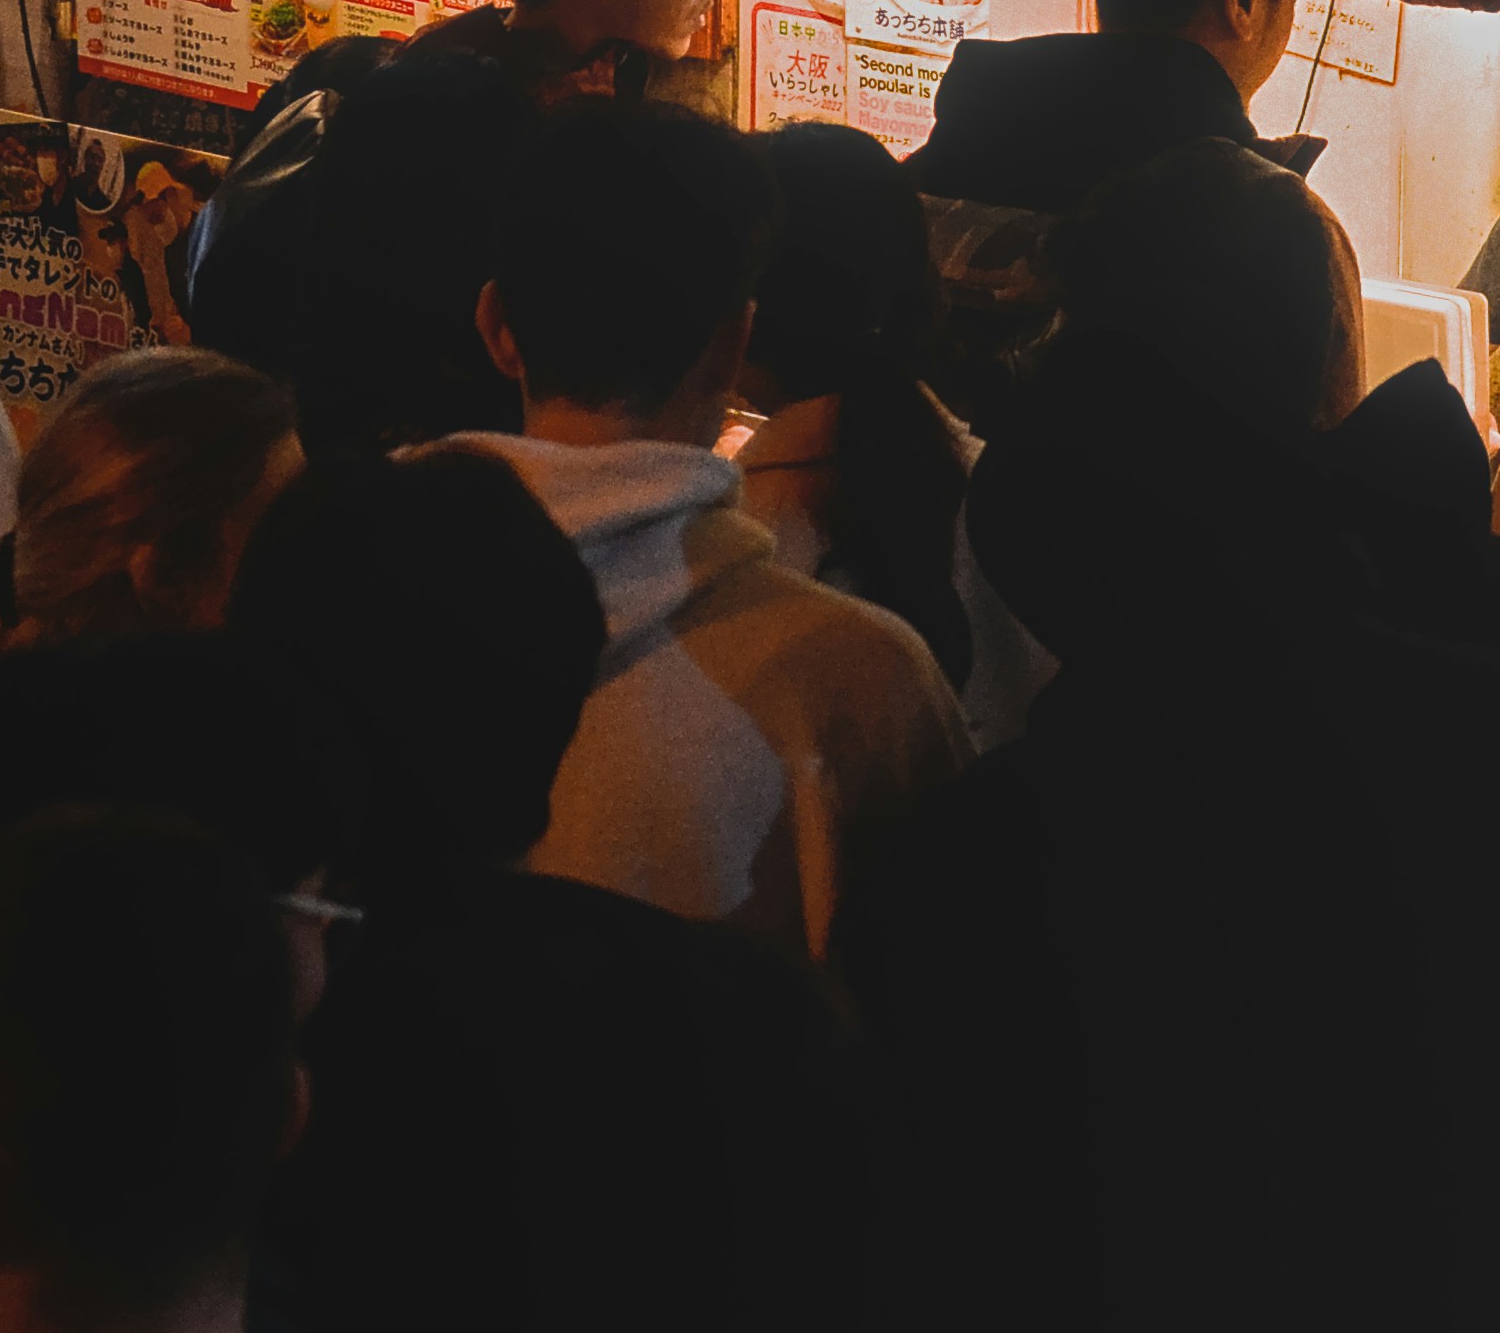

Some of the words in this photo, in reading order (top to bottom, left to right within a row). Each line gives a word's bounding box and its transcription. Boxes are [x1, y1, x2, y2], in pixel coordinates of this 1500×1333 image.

[874, 6, 965, 41] あっちち本舗
[787, 49, 831, 80] 大阪
[769, 70, 848, 98] いらっしゃい
[859, 75, 914, 97] popular
[918, 80, 931, 100] is
[859, 91, 889, 112] Soy
